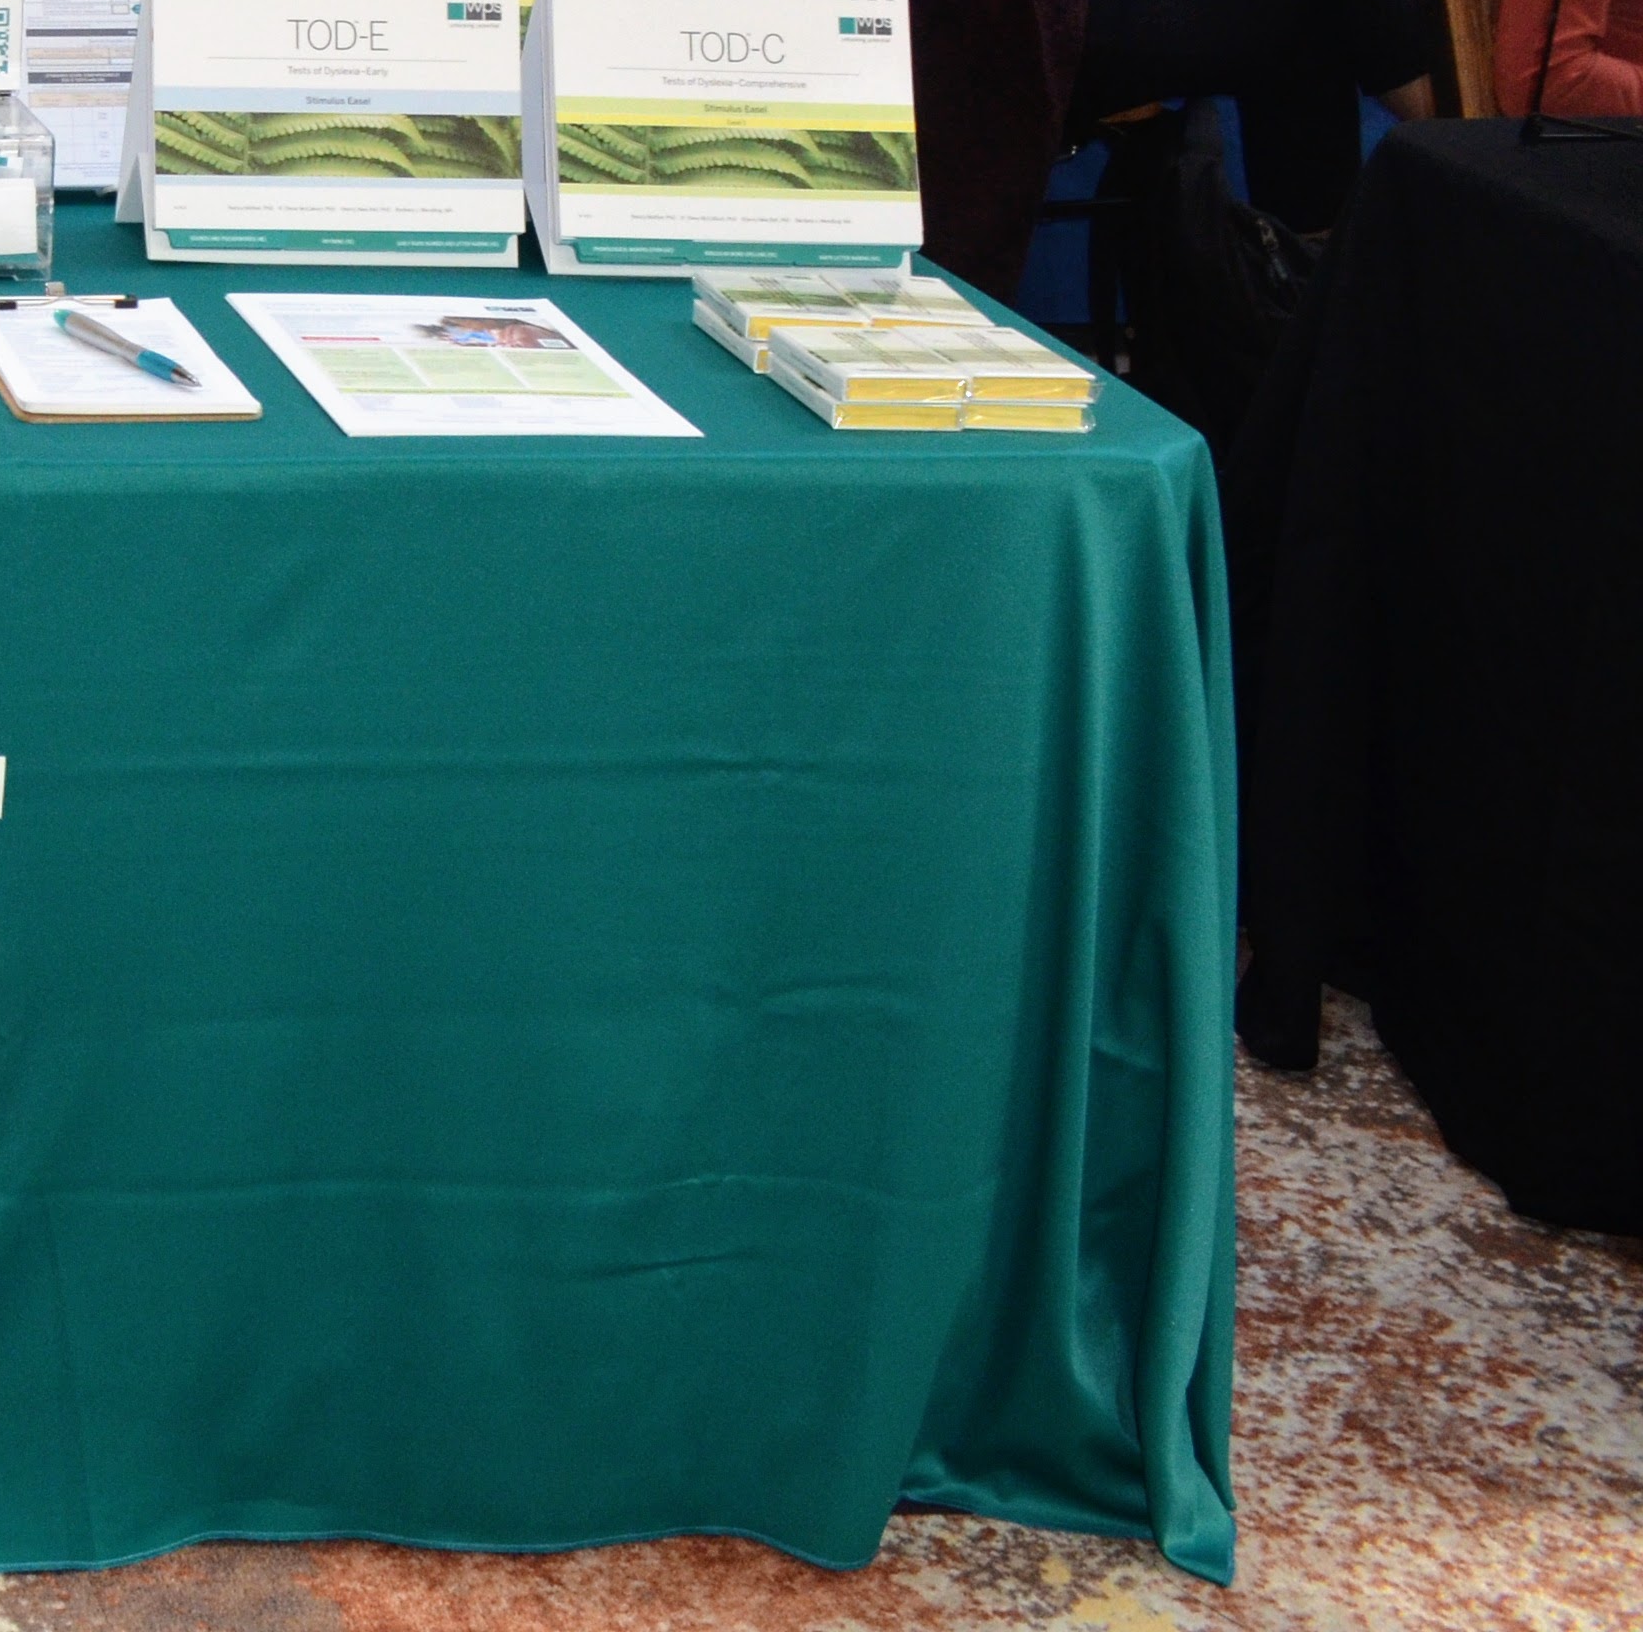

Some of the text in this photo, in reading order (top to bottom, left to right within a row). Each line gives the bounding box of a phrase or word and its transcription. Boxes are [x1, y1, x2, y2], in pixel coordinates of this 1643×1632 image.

[287, 66, 311, 76] Tests
[312, 66, 323, 76] of
[662, 76, 686, 87] Tests
[687, 77, 697, 87] of
[305, 96, 371, 106] Stimulus Easel
[704, 104, 768, 114] Stimulus Easel
